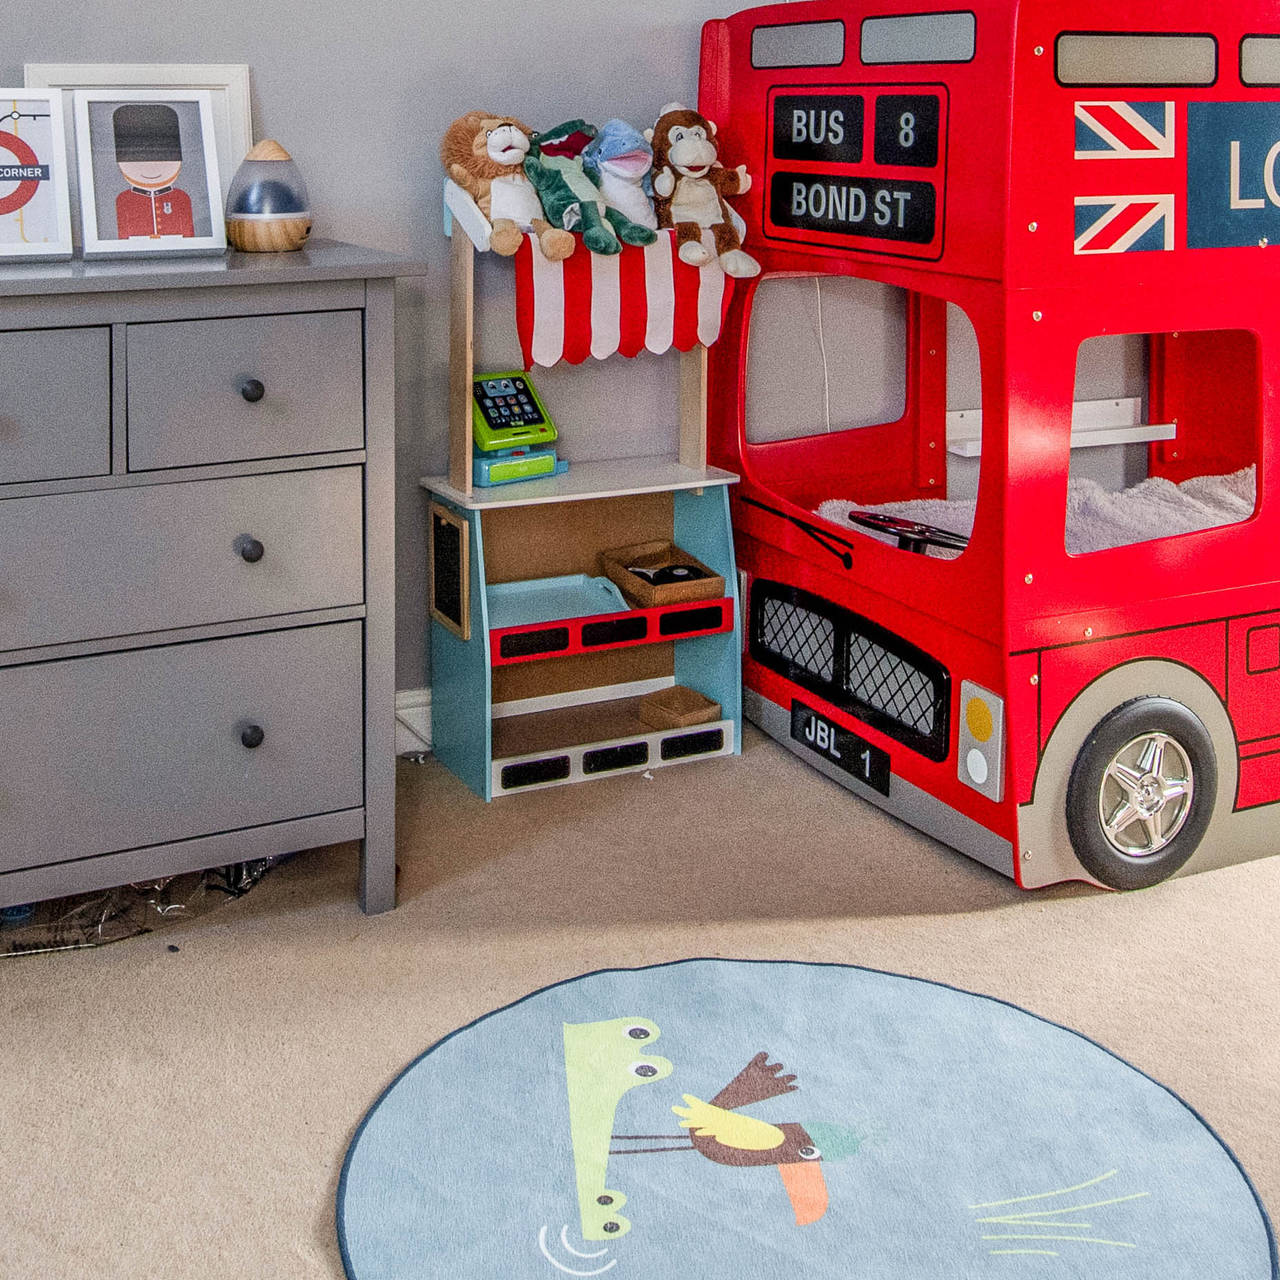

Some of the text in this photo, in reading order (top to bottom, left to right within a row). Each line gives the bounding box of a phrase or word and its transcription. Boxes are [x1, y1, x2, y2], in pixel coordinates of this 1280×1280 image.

[791, 109, 915, 148] BUS 8
[790, 182, 912, 228] BOND ST
[804, 716, 871, 778] JBL 1
